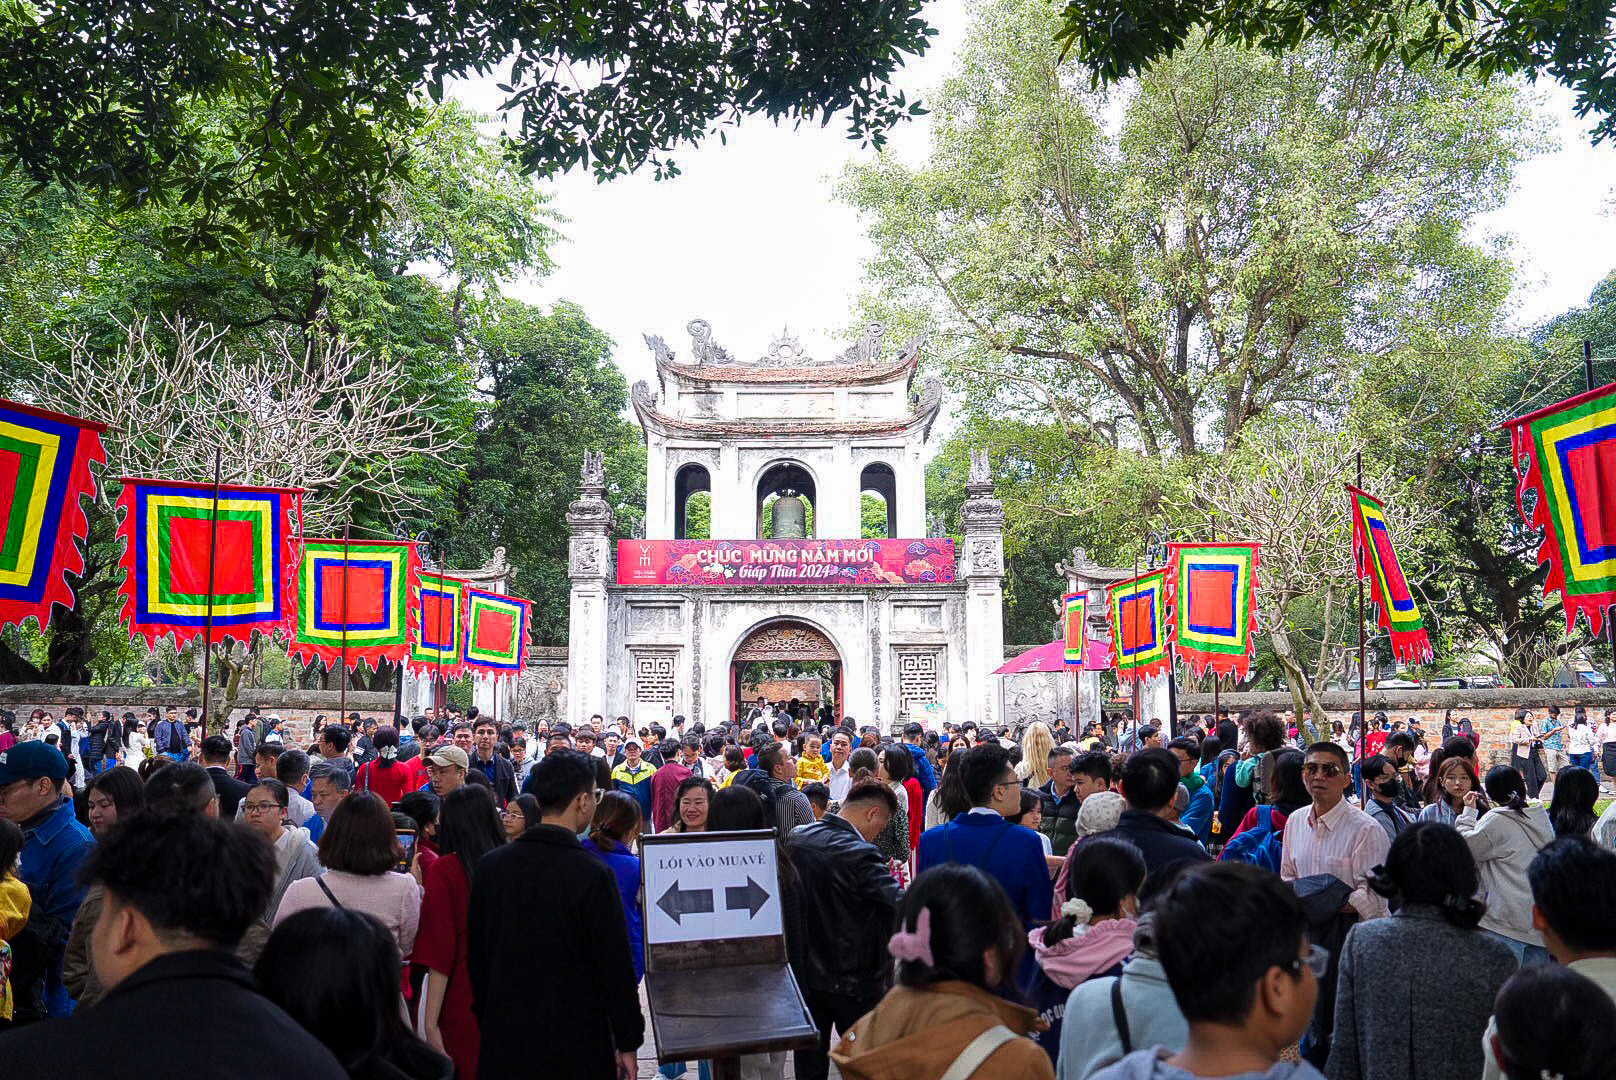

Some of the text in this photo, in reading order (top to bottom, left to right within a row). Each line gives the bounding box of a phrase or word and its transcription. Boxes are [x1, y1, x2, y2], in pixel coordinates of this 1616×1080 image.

[697, 545, 742, 562] CHÚC
[801, 546, 839, 562] NĂM
[843, 545, 874, 562] MỚI
[739, 564, 767, 581] Giáp
[800, 564, 830, 578] 2024
